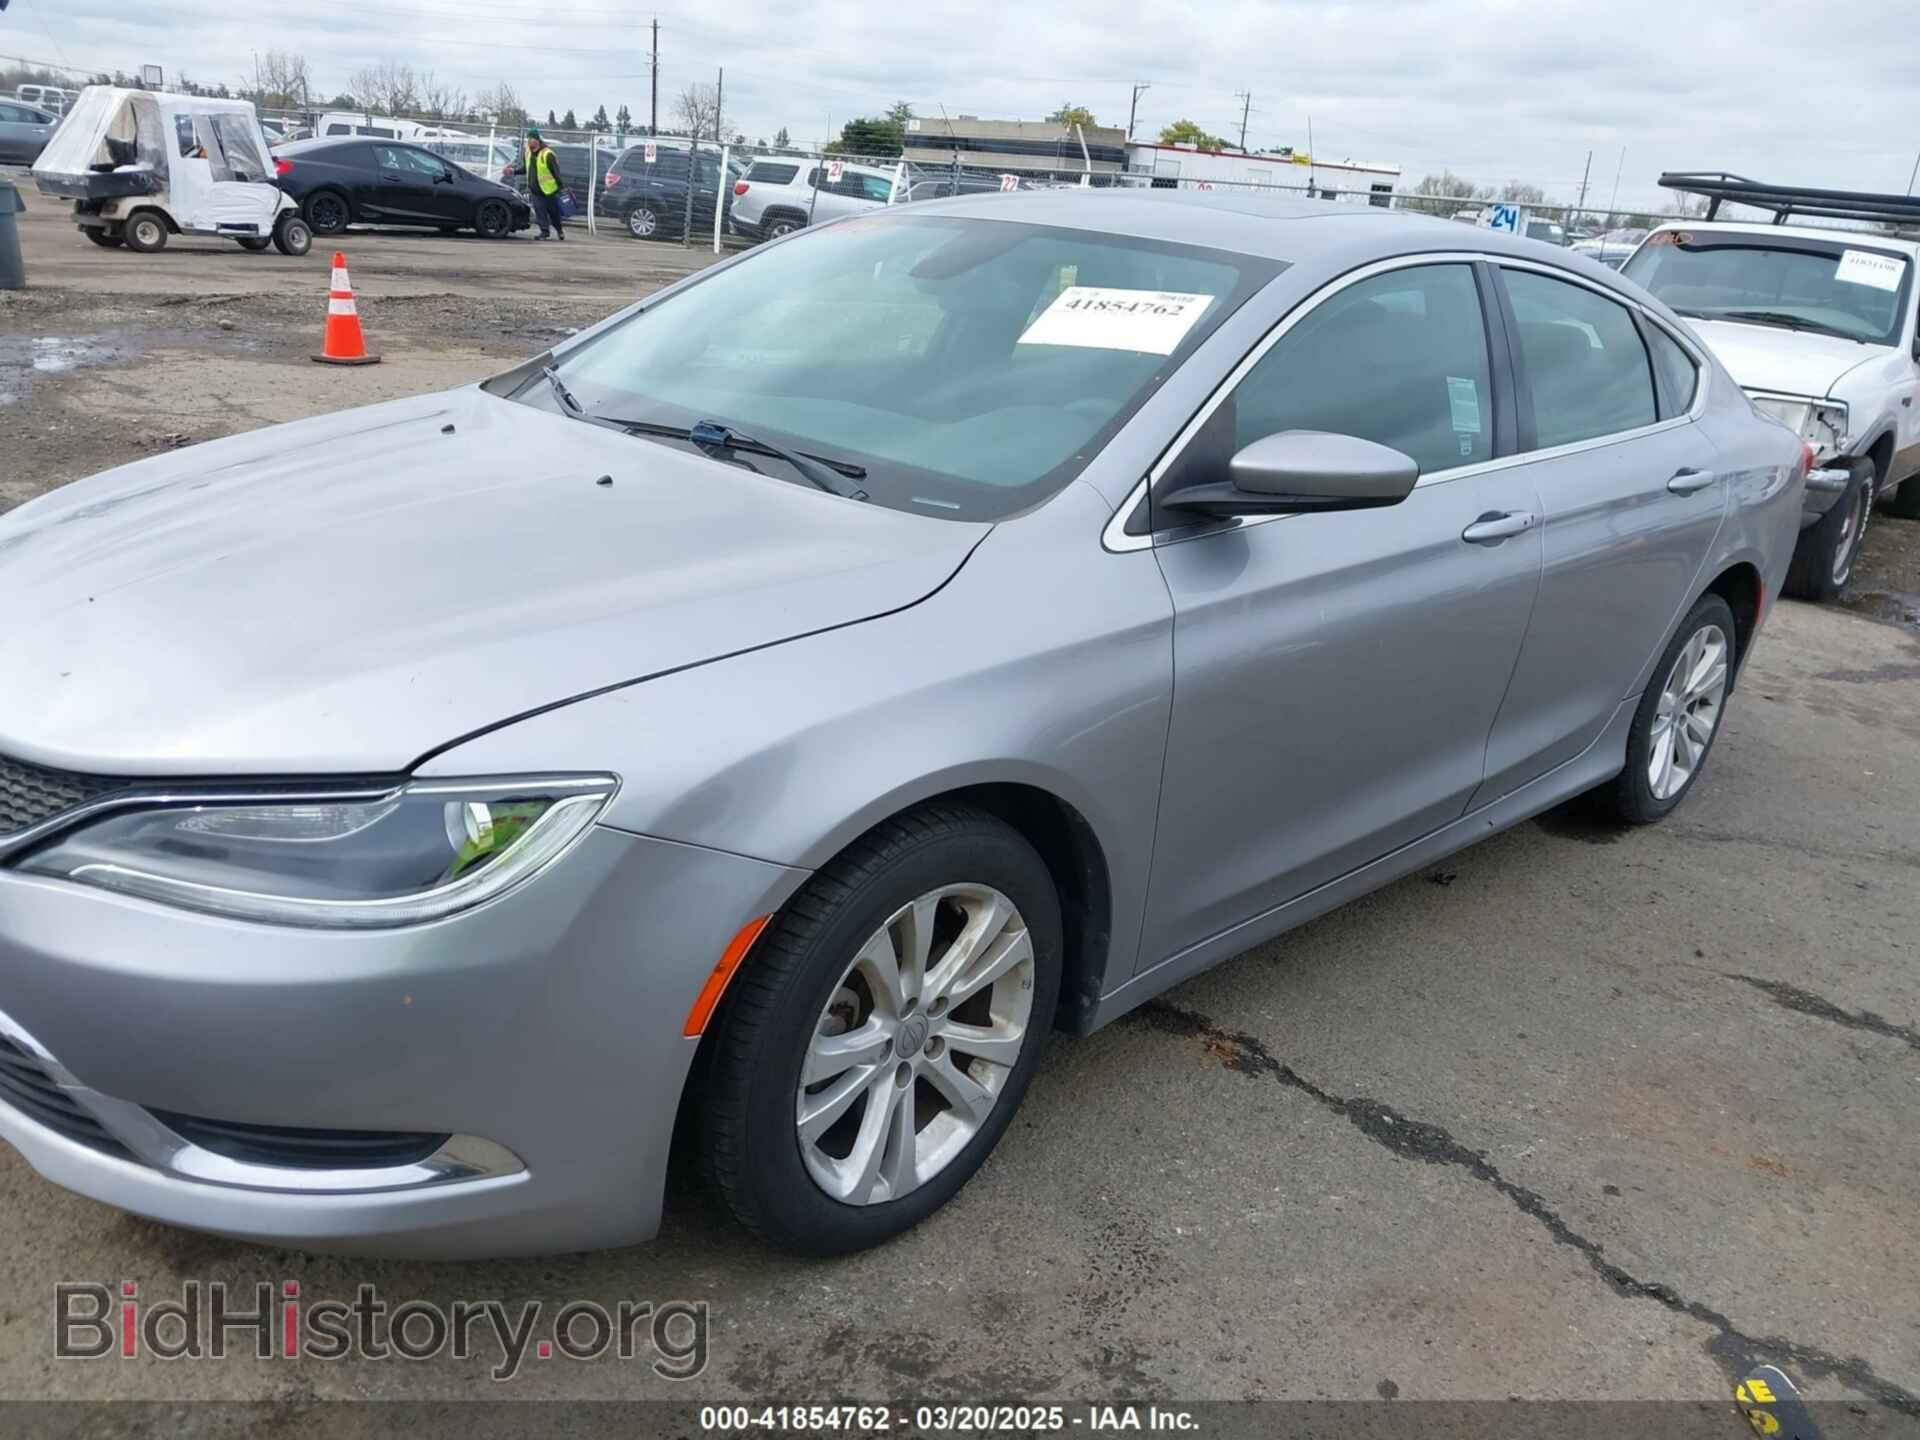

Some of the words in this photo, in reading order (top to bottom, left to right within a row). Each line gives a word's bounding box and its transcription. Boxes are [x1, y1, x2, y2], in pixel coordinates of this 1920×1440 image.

[830, 162, 843, 177] 21
[1491, 204, 1517, 232] 24
[1065, 298, 1185, 317] 41854762
